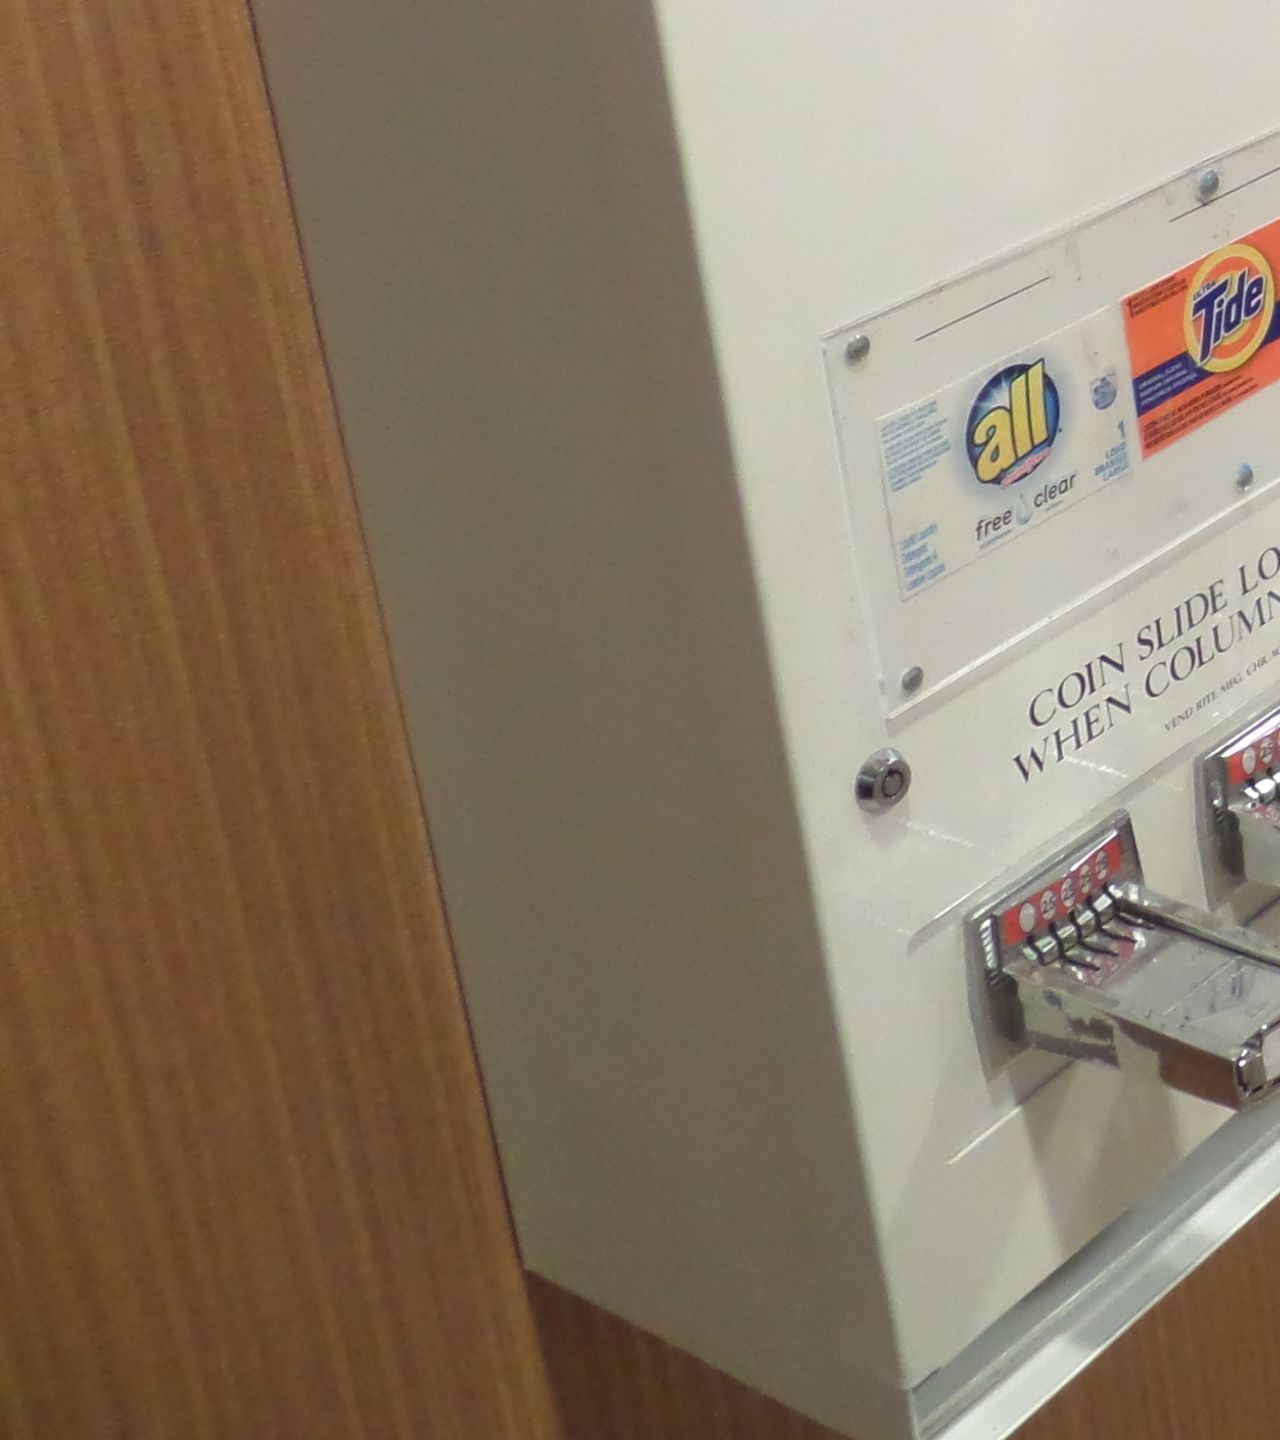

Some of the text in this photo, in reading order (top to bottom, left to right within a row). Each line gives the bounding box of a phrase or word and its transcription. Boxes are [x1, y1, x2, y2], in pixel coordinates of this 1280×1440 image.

[1191, 266, 1265, 368] Tide
[972, 357, 1050, 483] all
[975, 509, 1012, 541] free
[1033, 473, 1077, 508] clear
[1028, 642, 1125, 728] COIN
[1136, 578, 1228, 662] SLIDE
[1012, 686, 1132, 784] WHEN
[1164, 706, 1193, 732] VEND
